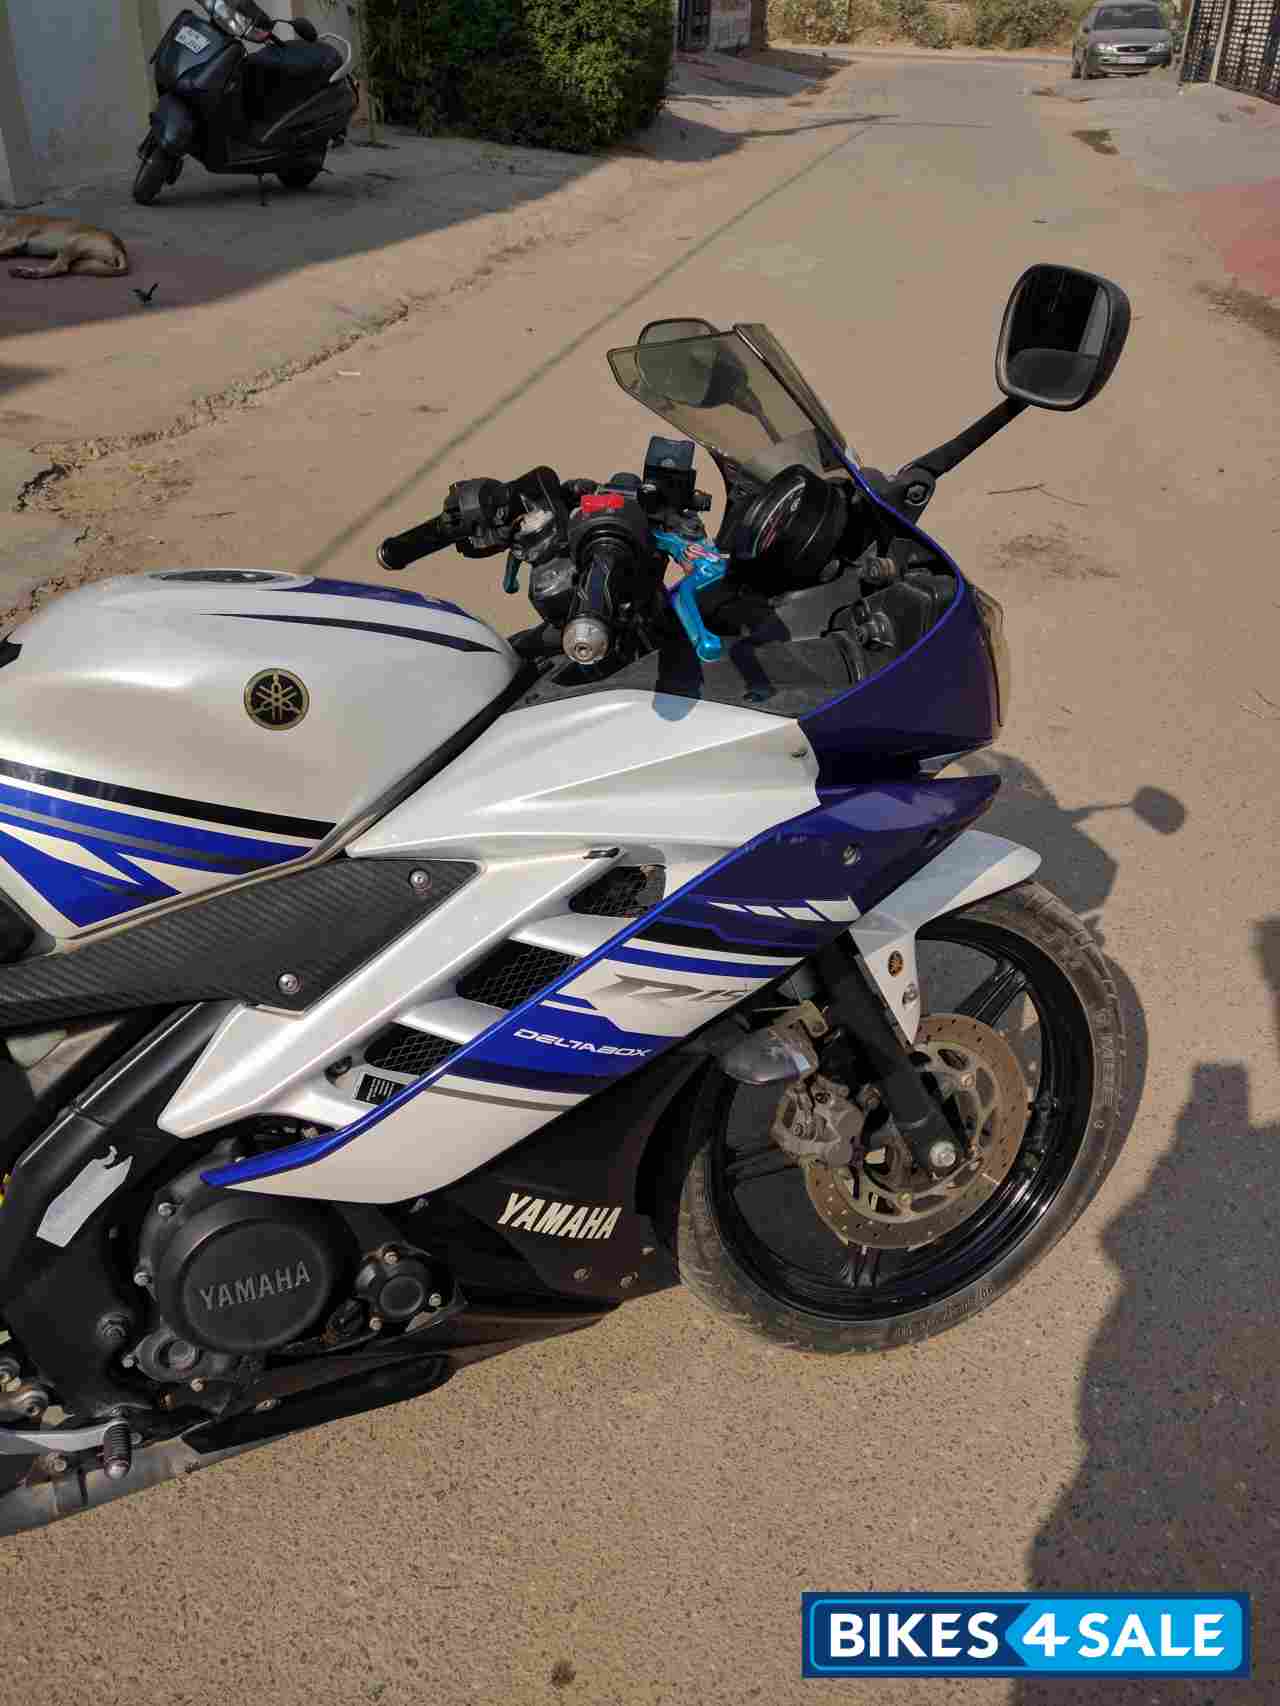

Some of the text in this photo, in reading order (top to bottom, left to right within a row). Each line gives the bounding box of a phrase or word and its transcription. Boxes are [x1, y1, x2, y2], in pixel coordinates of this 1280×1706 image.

[513, 1028, 653, 1057] DELTABOX
[497, 1192, 623, 1240] YAMAHA
[200, 1261, 312, 1313] YAMAHA
